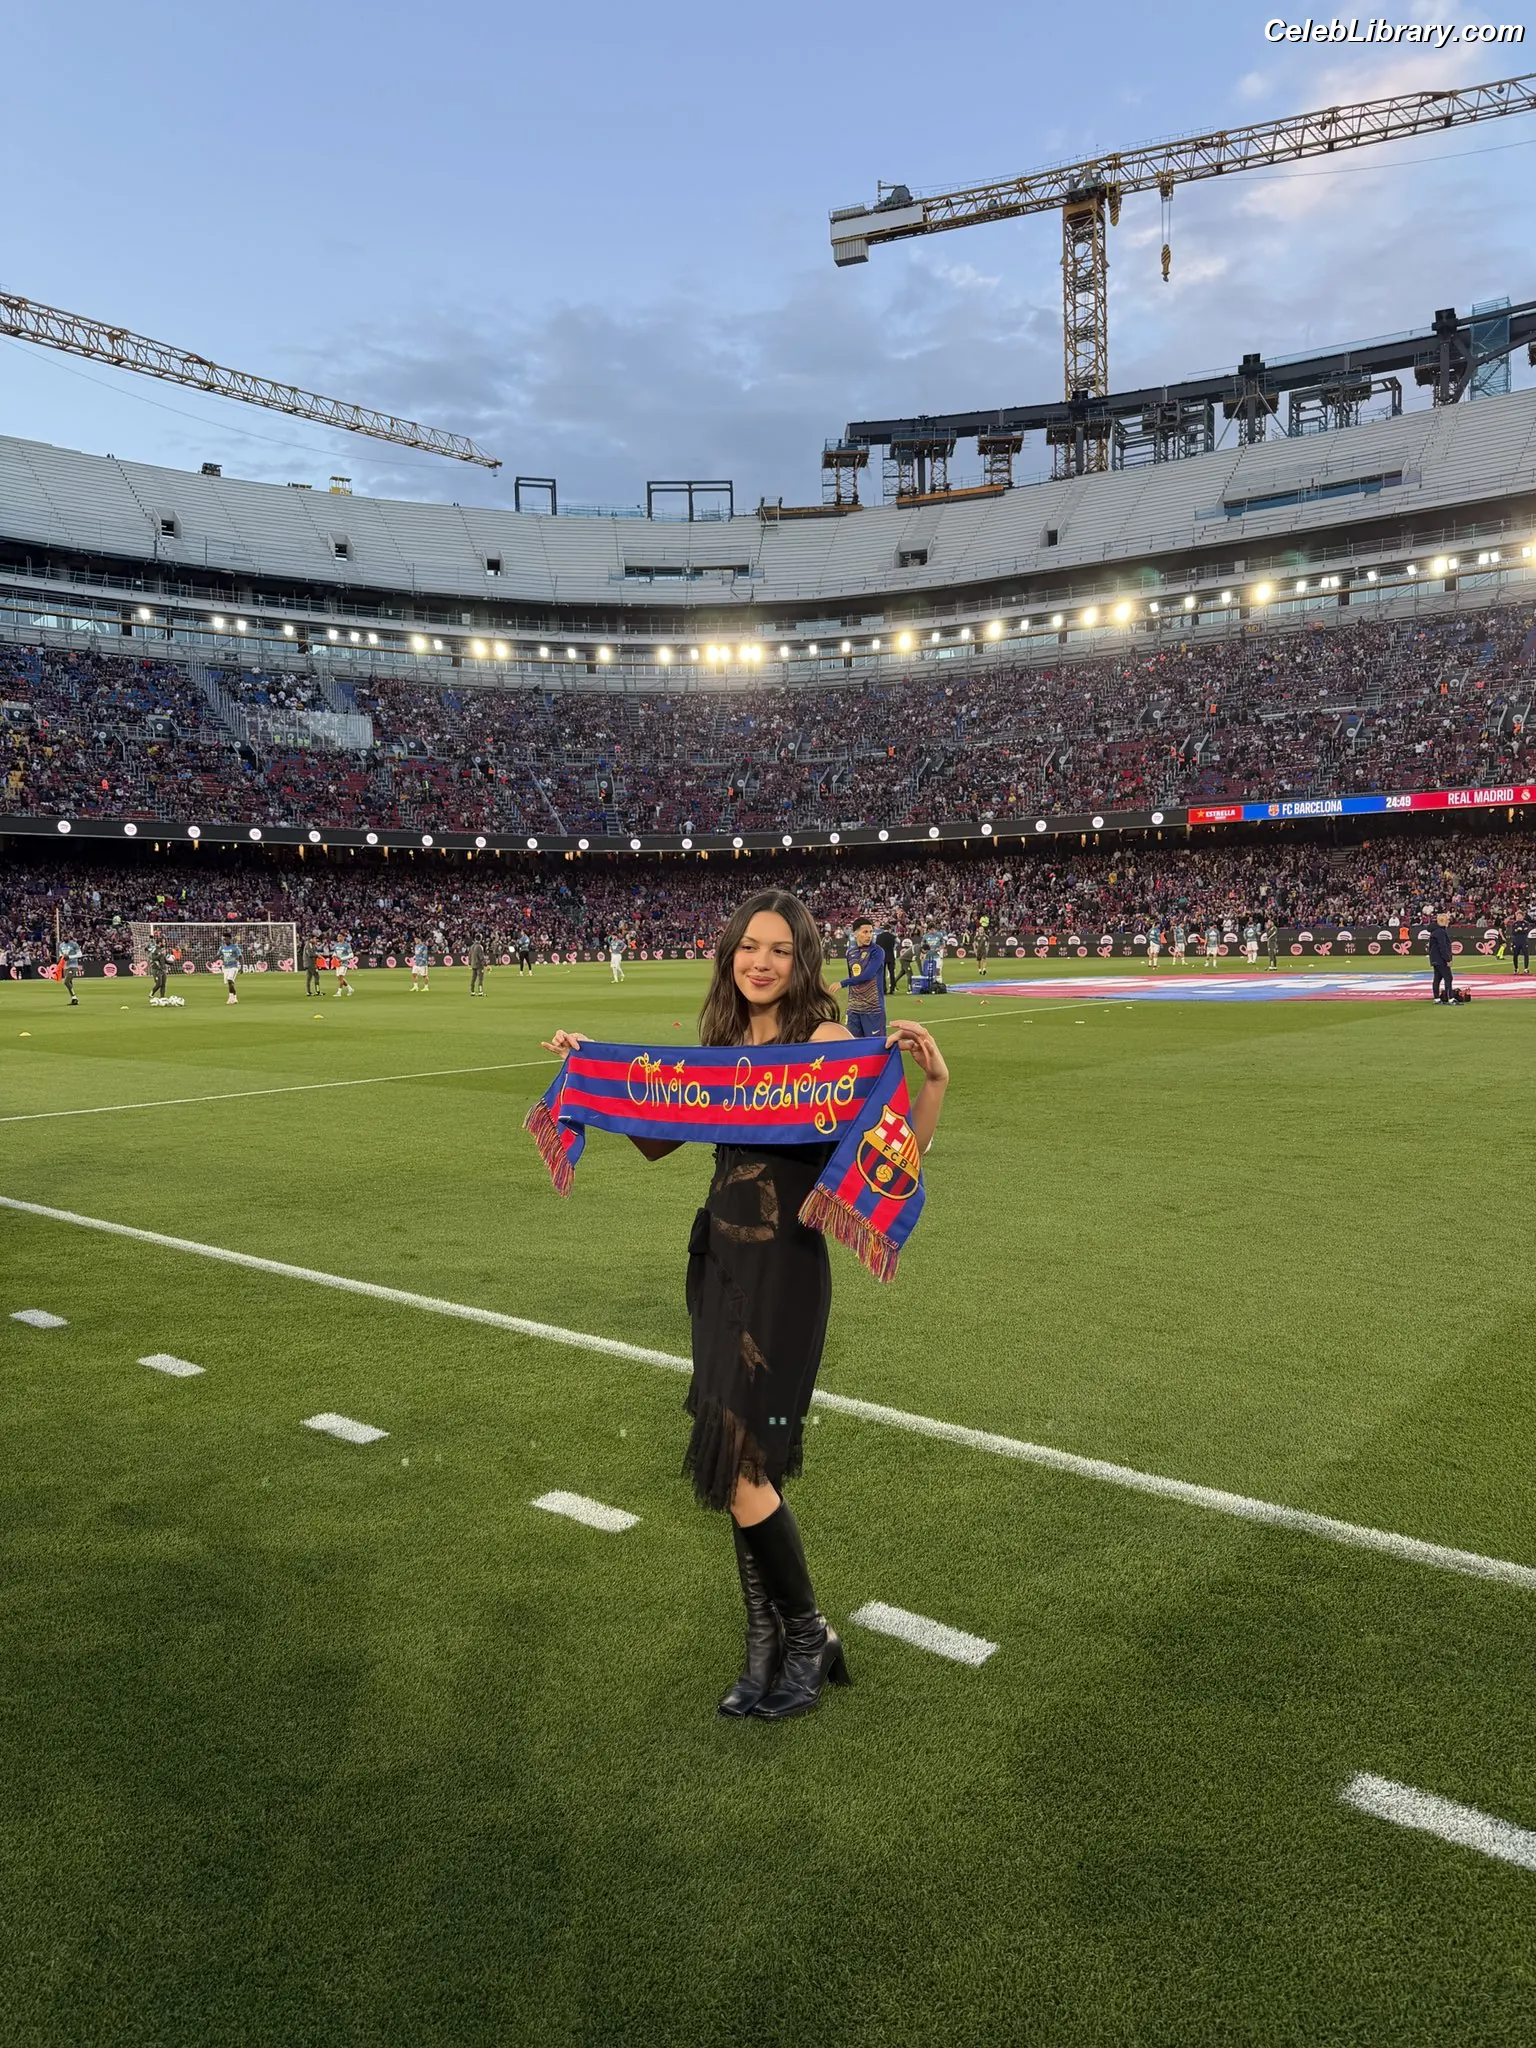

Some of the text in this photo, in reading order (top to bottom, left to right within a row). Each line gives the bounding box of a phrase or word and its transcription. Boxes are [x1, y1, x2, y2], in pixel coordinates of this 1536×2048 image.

[1385, 796, 1411, 808] 24:49
[1448, 789, 1514, 804] REAL MADRID
[1205, 809, 1236, 818] ESTRELLA
[1282, 800, 1342, 815] FC BARCELONA
[626, 1052, 859, 1135] Olivia Rodrigo
